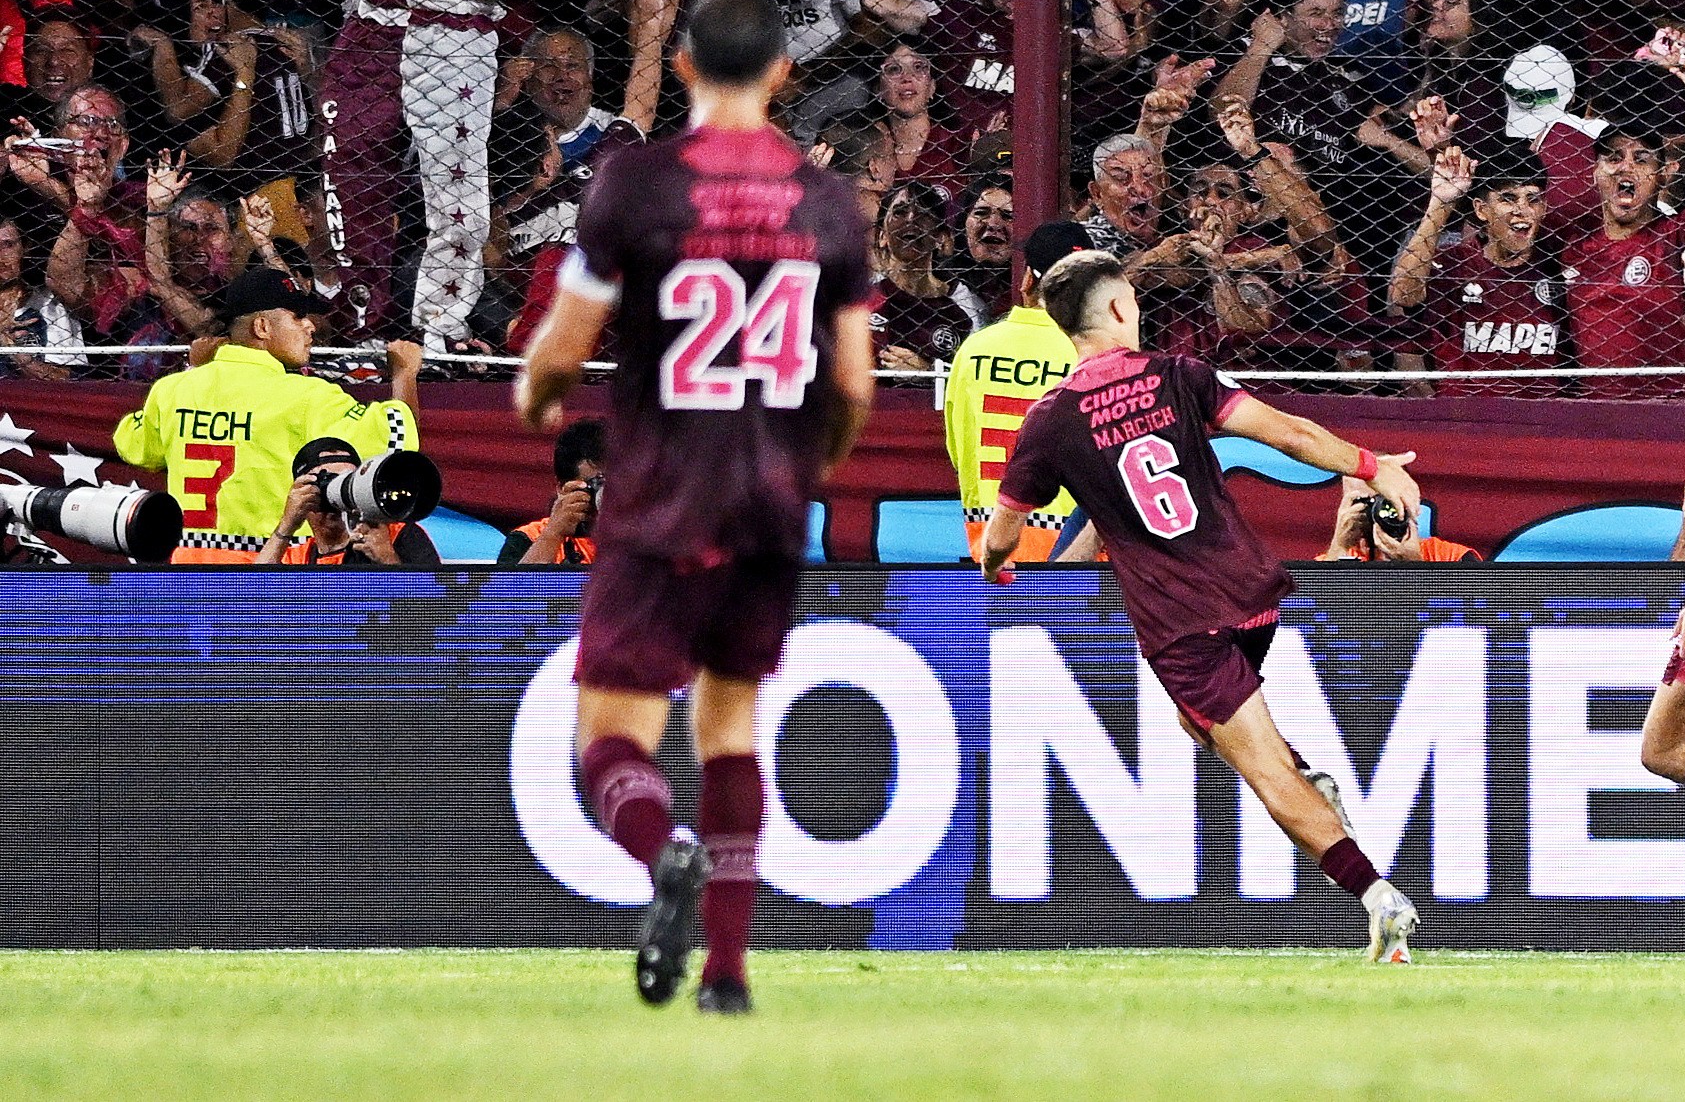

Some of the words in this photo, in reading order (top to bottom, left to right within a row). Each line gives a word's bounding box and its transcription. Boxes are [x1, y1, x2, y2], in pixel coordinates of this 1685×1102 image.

[659, 258, 821, 411] 24
[1463, 321, 1560, 356] MAPEI
[972, 355, 1071, 387] TECH
[1079, 373, 1164, 414] CIUDAD
[1089, 391, 1157, 430] MOTO
[175, 408, 253, 442] TECH
[1091, 405, 1177, 452] MARCICH
[1117, 433, 1199, 540] 6
